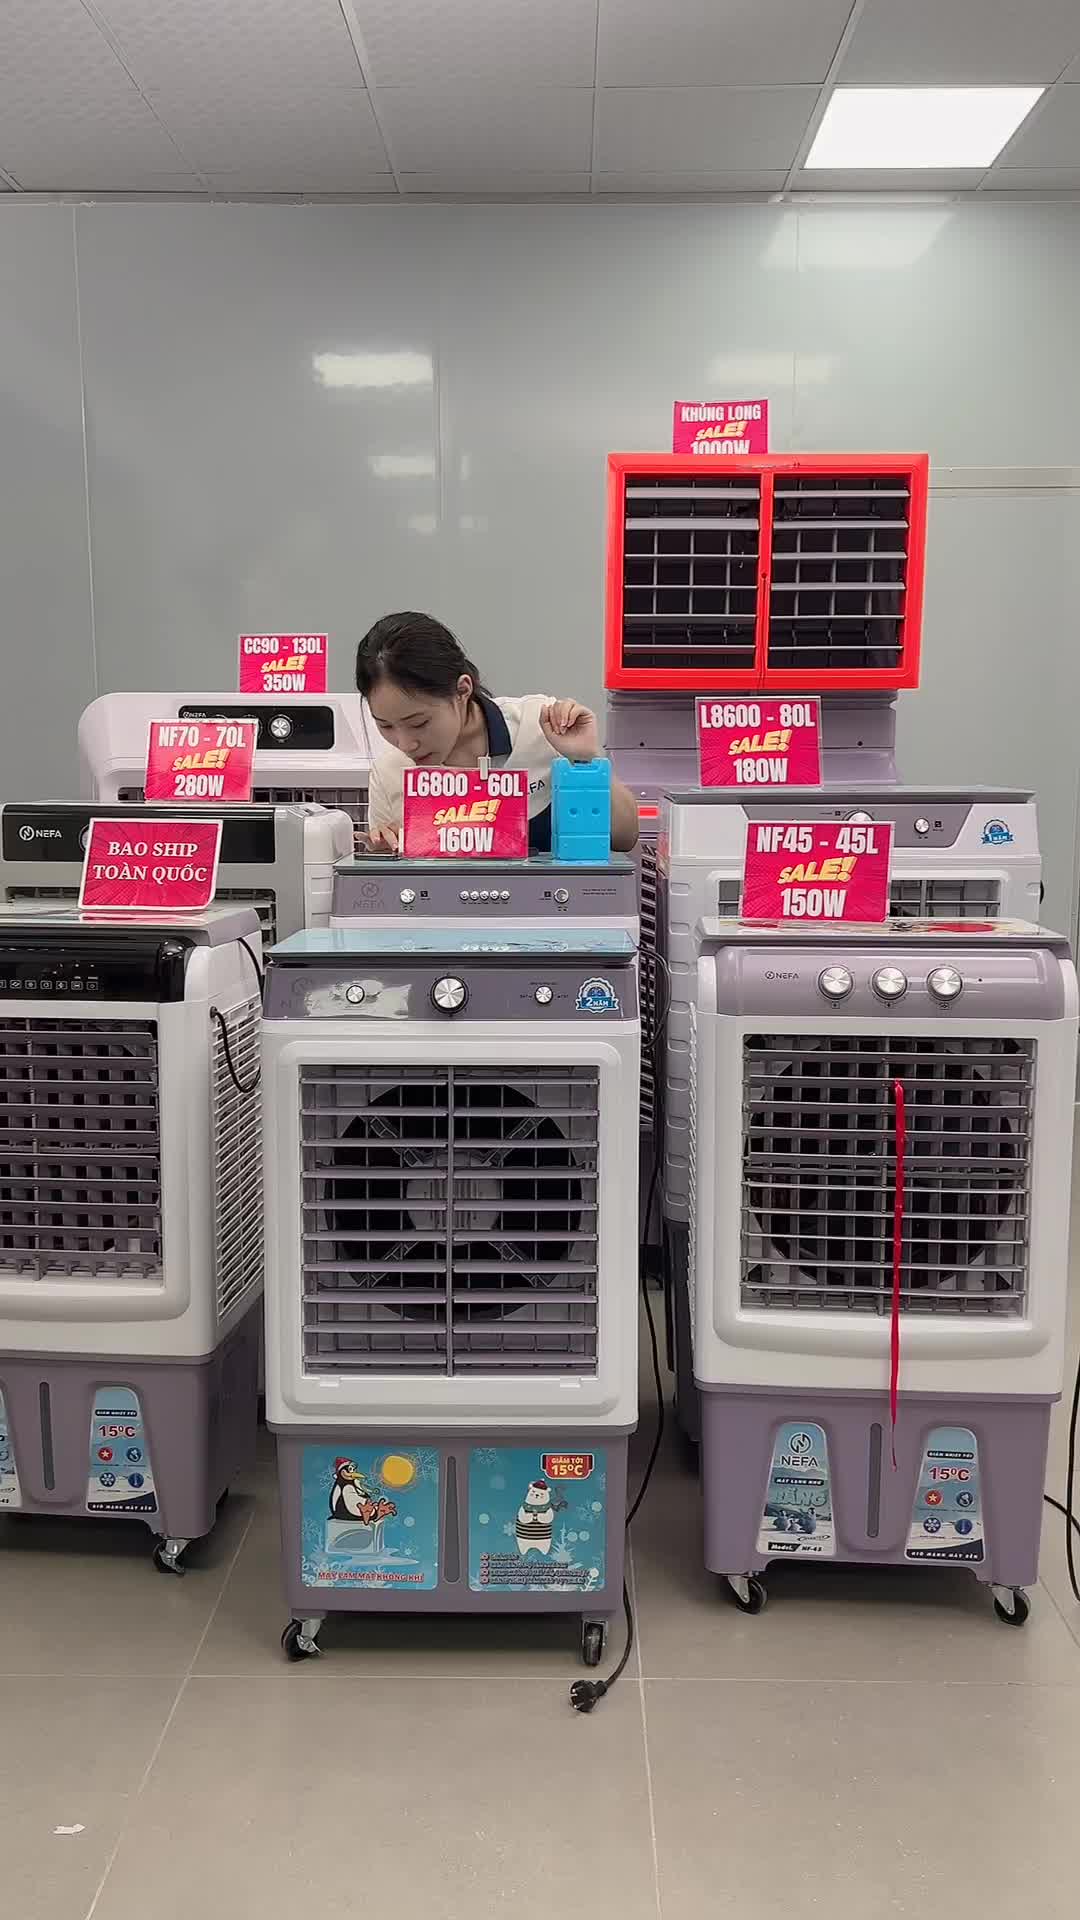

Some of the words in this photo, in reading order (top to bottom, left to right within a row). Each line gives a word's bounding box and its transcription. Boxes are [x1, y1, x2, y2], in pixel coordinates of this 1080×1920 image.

[681, 402, 724, 422] KHỦNG
[728, 404, 761, 421] LONG
[695, 420, 748, 441] SALE!
[690, 439, 751, 455] 1000W
[243, 637, 279, 655] CC90
[292, 637, 324, 654] 130L
[260, 655, 308, 673] SALE!
[263, 673, 306, 692] 350W
[700, 703, 761, 729] L8600
[779, 703, 816, 728] 80L
[158, 726, 200, 748] NF70
[216, 726, 246, 748] 70L
[727, 729, 793, 756] SALE!
[172, 748, 231, 772] SALE!
[732, 757, 789, 784] 180W
[173, 774, 225, 797] 280W
[407, 771, 468, 797] L6800
[487, 773, 524, 797] 60L
[432, 799, 502, 826] SALE!
[35, 829, 63, 838] NEFA
[437, 827, 494, 853] 160W
[756, 826, 813, 853] NF45
[835, 827, 879, 855] 45L
[107, 841, 148, 857] BAO
[151, 842, 198, 858] SHIP
[93, 862, 147, 881] TOÀN
[151, 863, 208, 884] QUỐC
[777, 856, 858, 885] SALE!
[780, 888, 847, 918] 150W
[781, 1455, 819, 1467] NEFA
